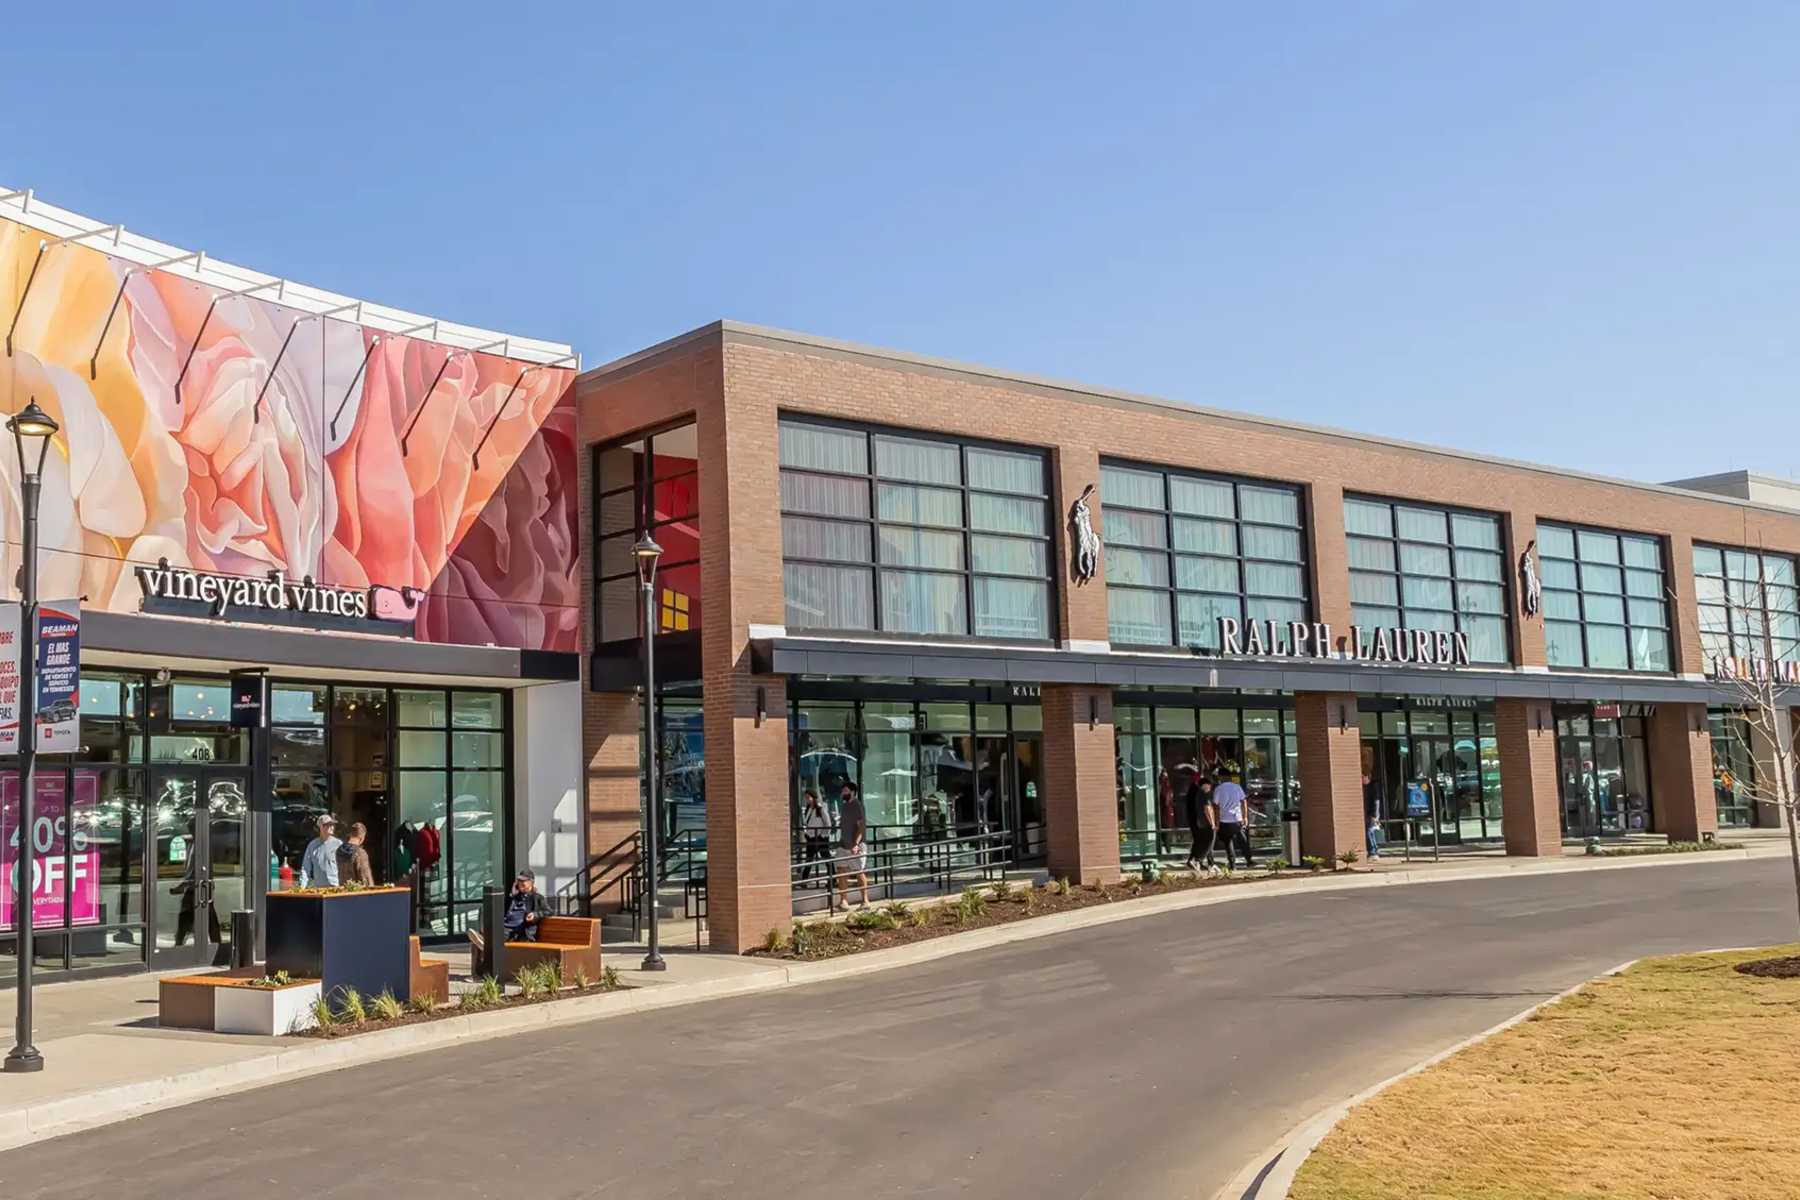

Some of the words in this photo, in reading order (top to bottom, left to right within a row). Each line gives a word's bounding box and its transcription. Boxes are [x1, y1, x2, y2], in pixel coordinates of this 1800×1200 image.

[143, 560, 288, 616] vineyard
[291, 578, 368, 618] vines
[42, 624, 78, 634] BEAMAN
[0, 631, 14, 644] BRE
[1218, 617, 1333, 659] RALPH
[1351, 625, 1471, 665] LAUREN
[48, 643, 55, 654] EL
[46, 654, 71, 666] GRANDE
[192, 748, 210, 760] 408
[41, 805, 49, 813] UP
[10, 855, 88, 894] OFF
[33, 897, 65, 905] VERYTHIN
